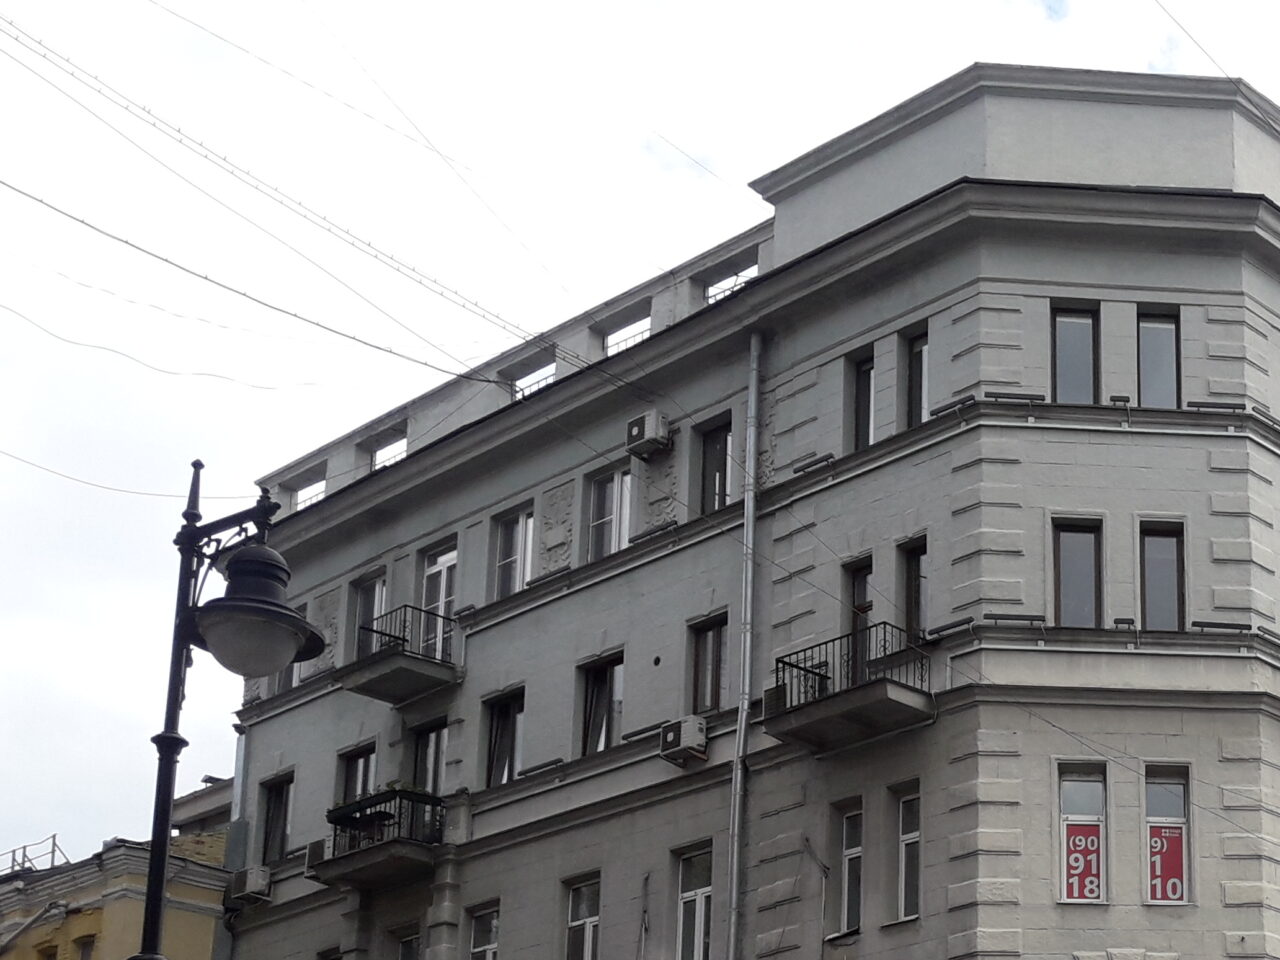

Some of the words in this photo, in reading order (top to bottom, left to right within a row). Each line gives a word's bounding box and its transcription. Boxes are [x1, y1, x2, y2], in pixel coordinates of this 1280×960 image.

[1069, 836, 1098, 850] (90
[1151, 838, 1167, 852] 9)
[1069, 853, 1098, 875] 91
[1151, 855, 1161, 876] 1
[1068, 876, 1099, 898] 18
[1151, 878, 1182, 899] 10
